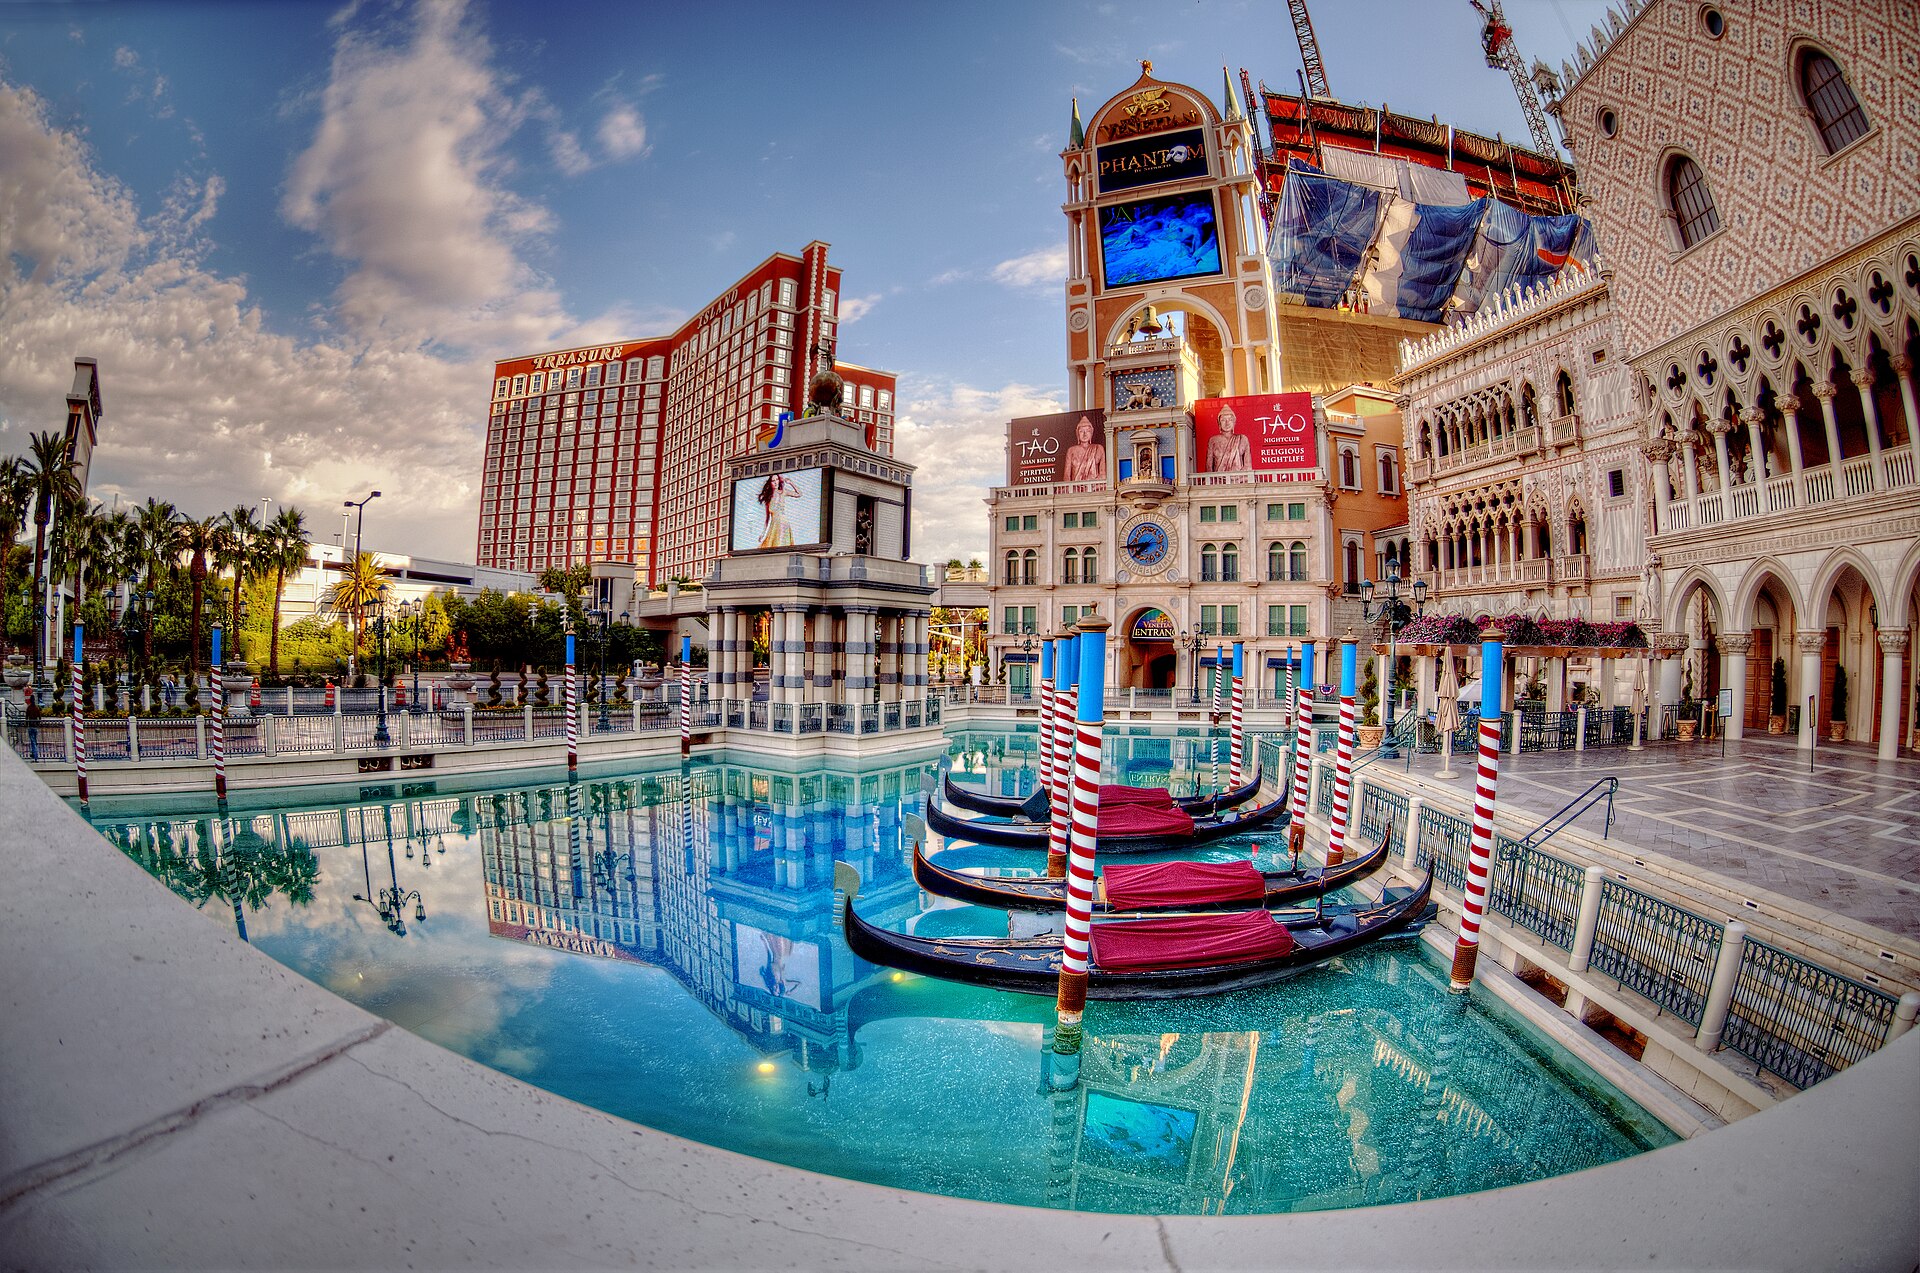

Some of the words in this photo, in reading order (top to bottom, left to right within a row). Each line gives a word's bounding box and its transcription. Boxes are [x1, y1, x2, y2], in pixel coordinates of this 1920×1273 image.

[533, 345, 623, 370] TREASURE
[1253, 414, 1306, 435] TAO
[1015, 436, 1059, 458] TAO
[1261, 455, 1305, 463] NIGHTLIFE
[1019, 467, 1056, 477] SPIRITUAL
[1023, 475, 1052, 484] DINING
